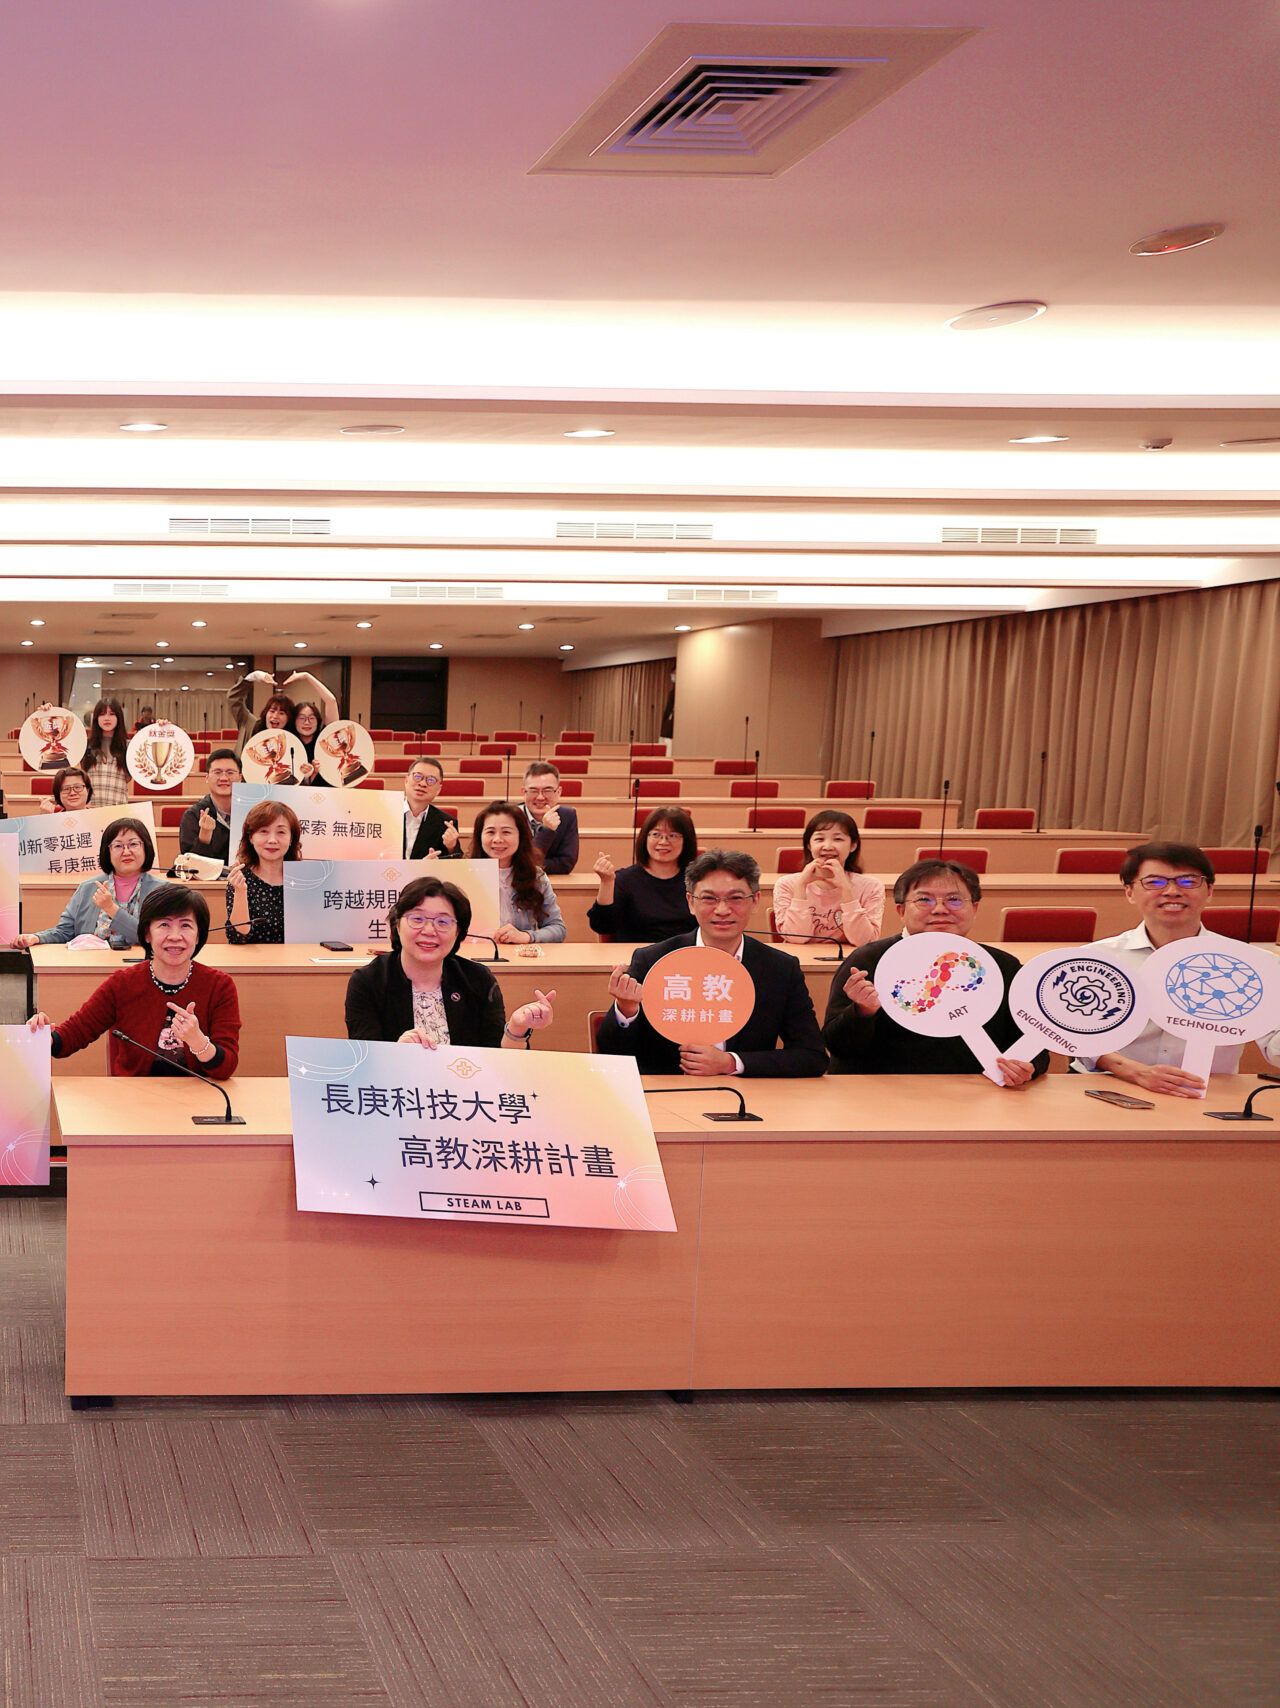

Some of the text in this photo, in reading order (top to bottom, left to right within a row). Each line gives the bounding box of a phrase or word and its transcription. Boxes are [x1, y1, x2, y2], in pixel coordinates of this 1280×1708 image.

[332, 820, 383, 839] 無極限
[663, 973, 734, 1002] 高教
[1070, 964, 1126, 1005] ENGINEERING
[661, 1008, 734, 1024] 深耕計畫
[948, 1005, 969, 1020] ART
[1016, 1009, 1078, 1053] ENGINEERING
[1166, 1016, 1246, 1037] TECHNOLOGY
[322, 1083, 531, 1125] 長庚科技大學
[398, 1135, 619, 1179] 高教深耕計畫
[447, 1197, 522, 1211] STEAM LAB
